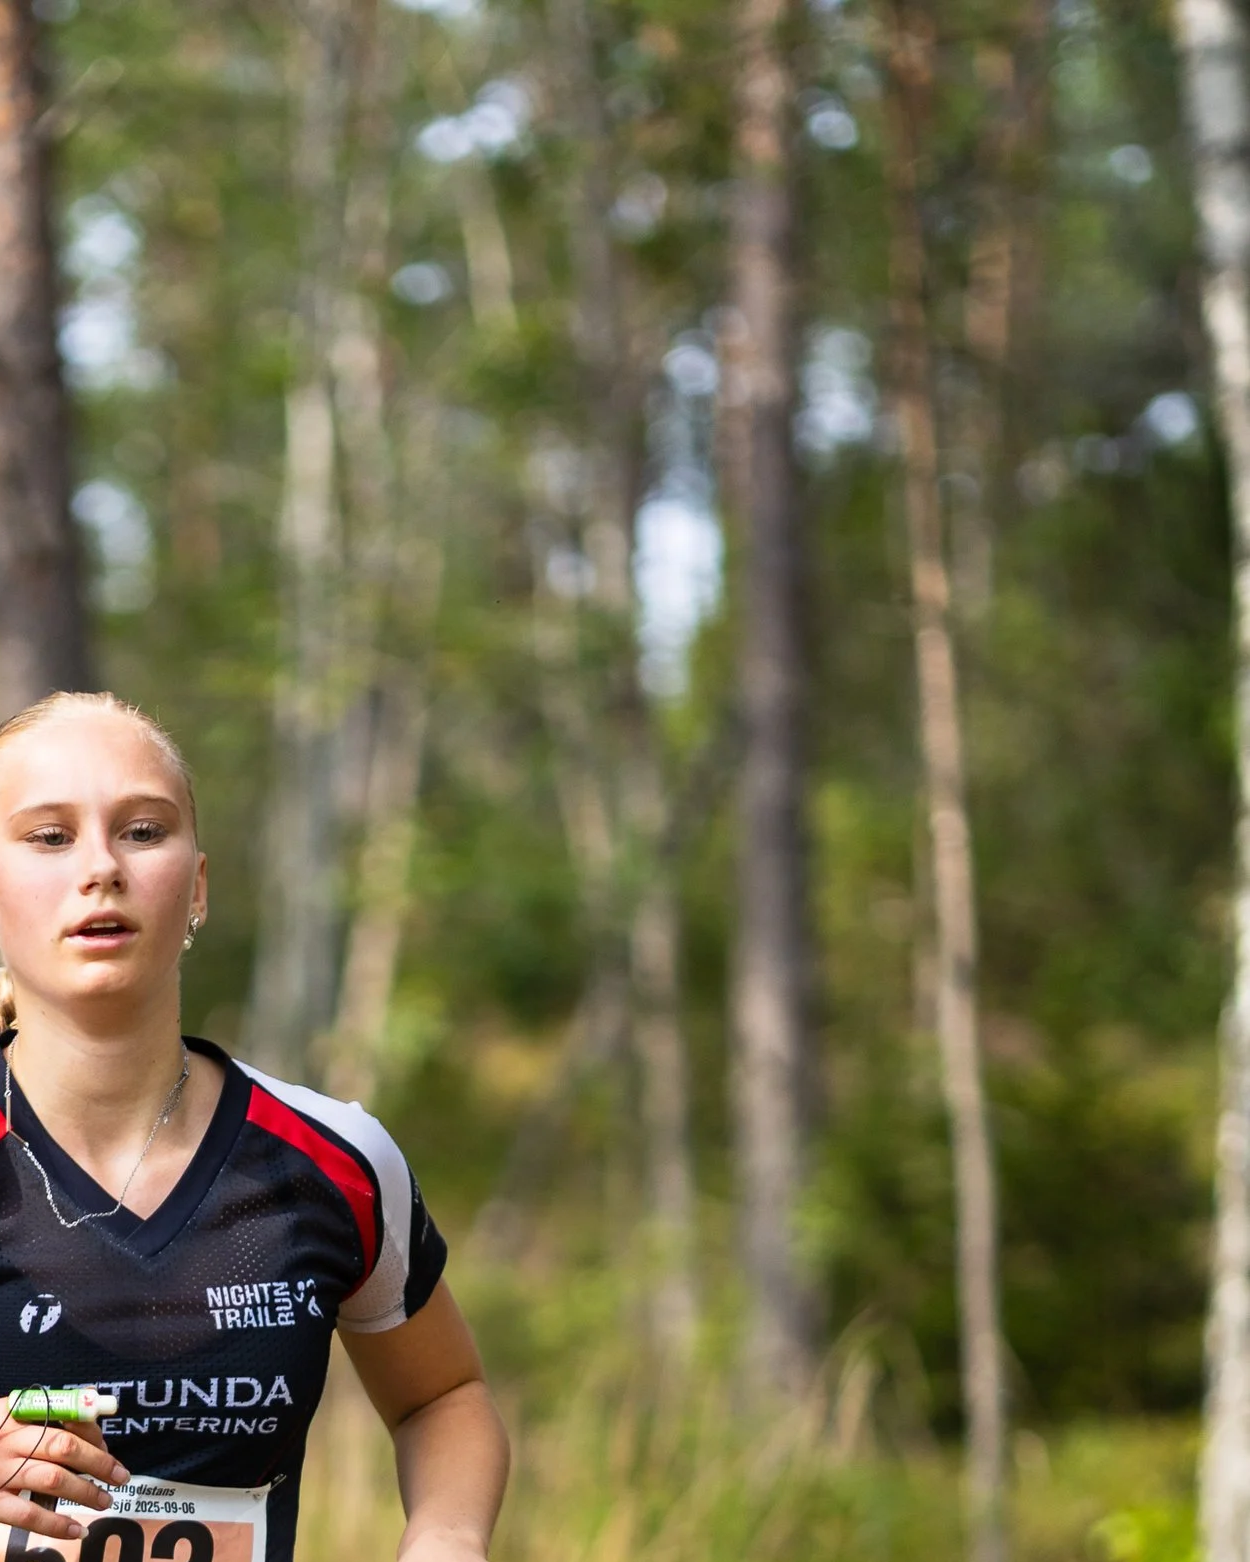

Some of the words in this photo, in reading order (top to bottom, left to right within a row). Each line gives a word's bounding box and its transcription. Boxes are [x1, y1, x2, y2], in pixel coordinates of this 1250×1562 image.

[206, 1283, 271, 1308] NIGHT
[272, 1281, 295, 1326] RUN
[210, 1306, 277, 1330] TRAIL
[44, 1375, 293, 1408] TUNDA
[102, 1416, 278, 1435] ENTERING
[135, 1500, 196, 1514] 2025-09-06
